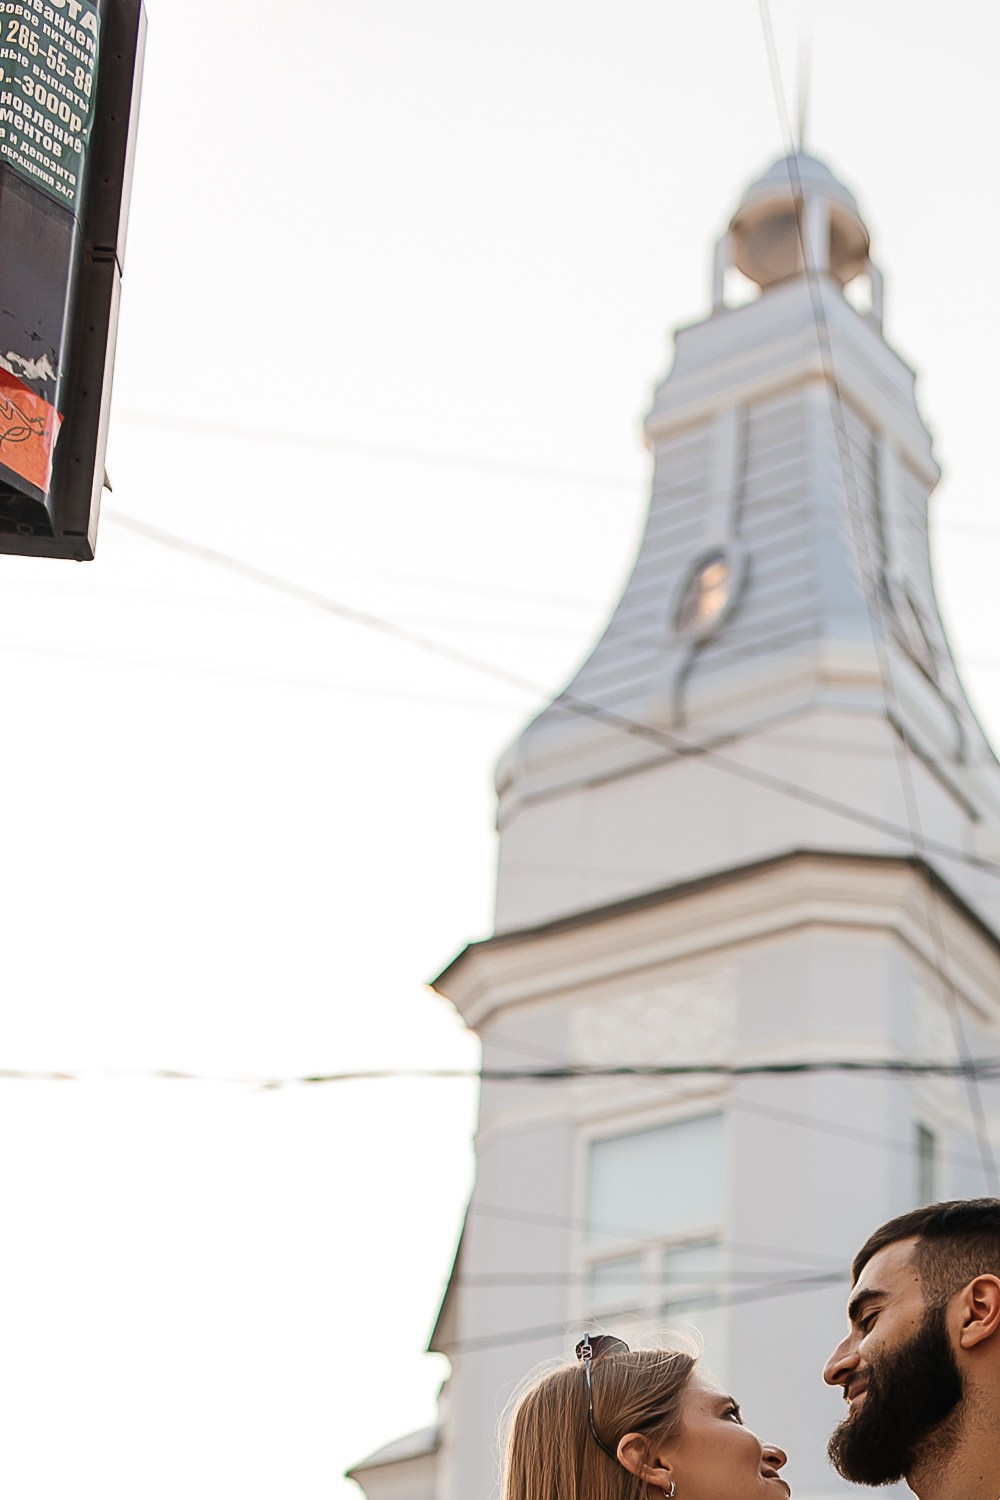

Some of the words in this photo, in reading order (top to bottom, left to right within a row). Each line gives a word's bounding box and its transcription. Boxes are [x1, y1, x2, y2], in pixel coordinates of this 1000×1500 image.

[22, 0, 96, 57] ванием
[42, 23, 95, 71] питание
[6, 20, 93, 98] 265-55-88
[32, 64, 90, 113] выплаты
[0, 144, 55, 187] ОБРАЩЕНИЯ
[55, 181, 75, 200] 24/7
[9, 132, 18, 145] и
[20, 140, 77, 186] депозита
